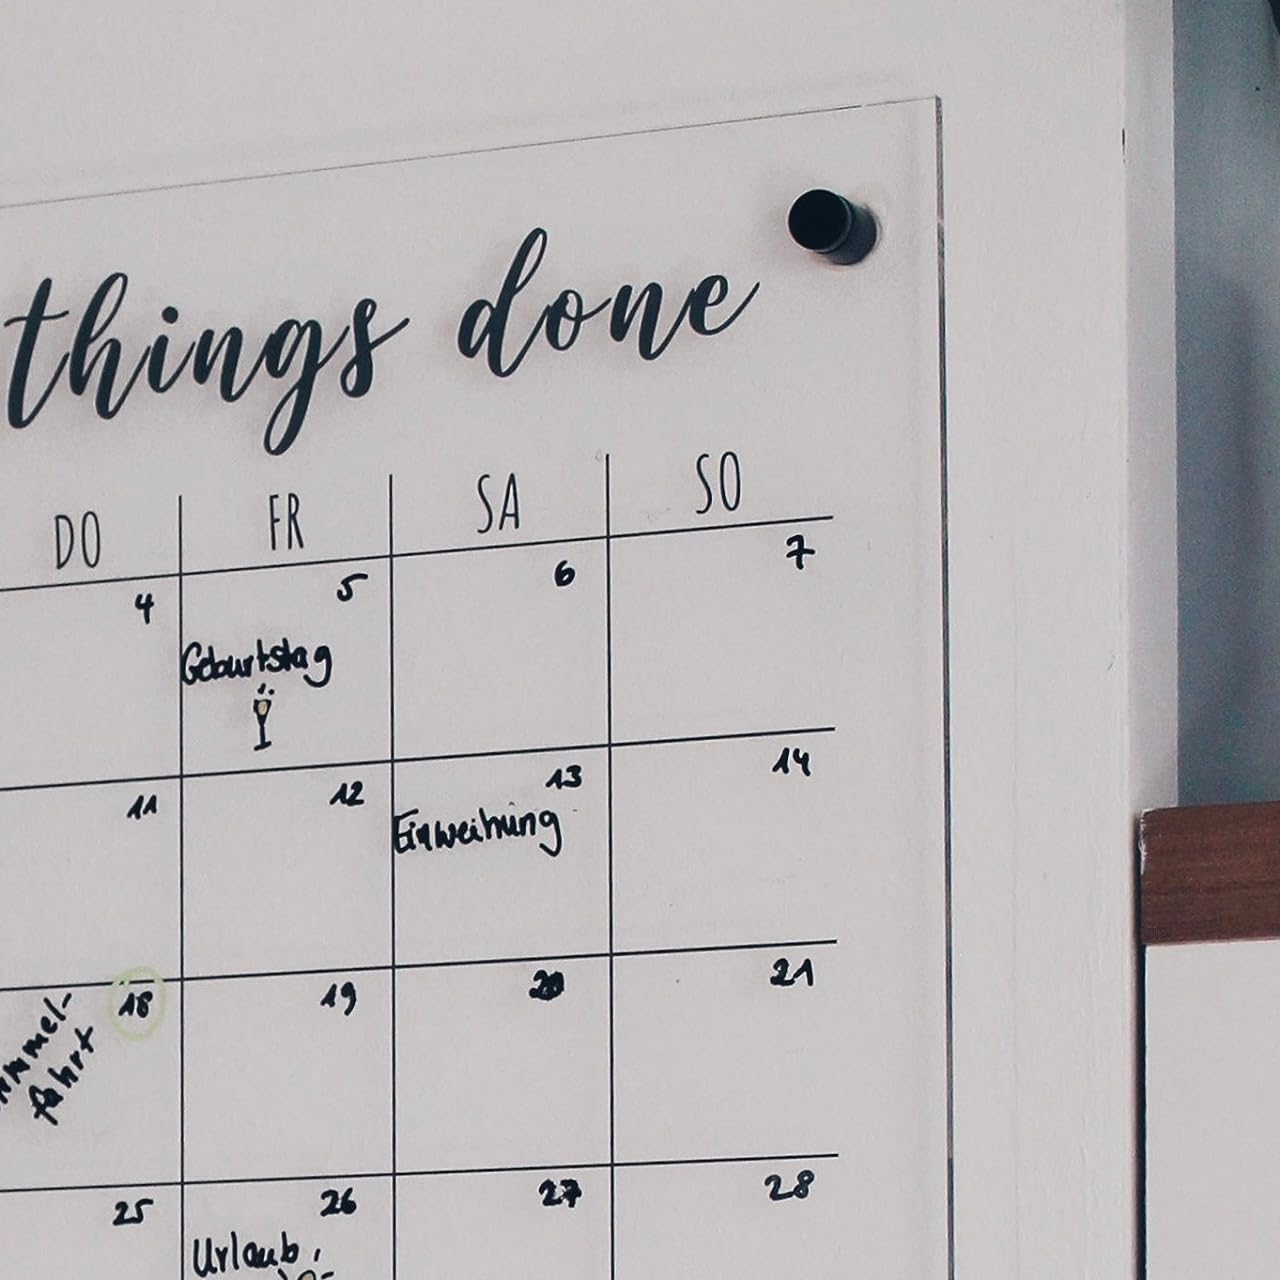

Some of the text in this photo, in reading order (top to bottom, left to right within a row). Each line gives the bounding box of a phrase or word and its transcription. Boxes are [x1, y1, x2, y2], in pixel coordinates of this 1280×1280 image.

[3, 272, 409, 457] things
[457, 227, 761, 377] done
[695, 451, 741, 515] SO
[476, 472, 520, 535] SA
[269, 492, 305, 551] FR
[54, 510, 101, 570] DO
[785, 534, 816, 571] 7
[336, 572, 370, 604] 5
[554, 559, 576, 587] 6
[134, 592, 155, 625] 4
[180, 637, 334, 688] Geburtstag
[544, 764, 583, 790] 13
[771, 746, 812, 777] 14
[126, 794, 158, 821] 11
[329, 780, 365, 807] 12
[391, 808, 564, 858] Einweihung
[769, 957, 814, 987] 21
[118, 990, 156, 1020] 18
[319, 981, 357, 1017] 19
[28, 1024, 97, 1126] fahrt
[319, 1186, 358, 1218] 26
[538, 1178, 583, 1209] 27
[764, 1169, 815, 1202] 28
[112, 1197, 155, 1227] 25
[192, 1230, 300, 1276] Urlaub
